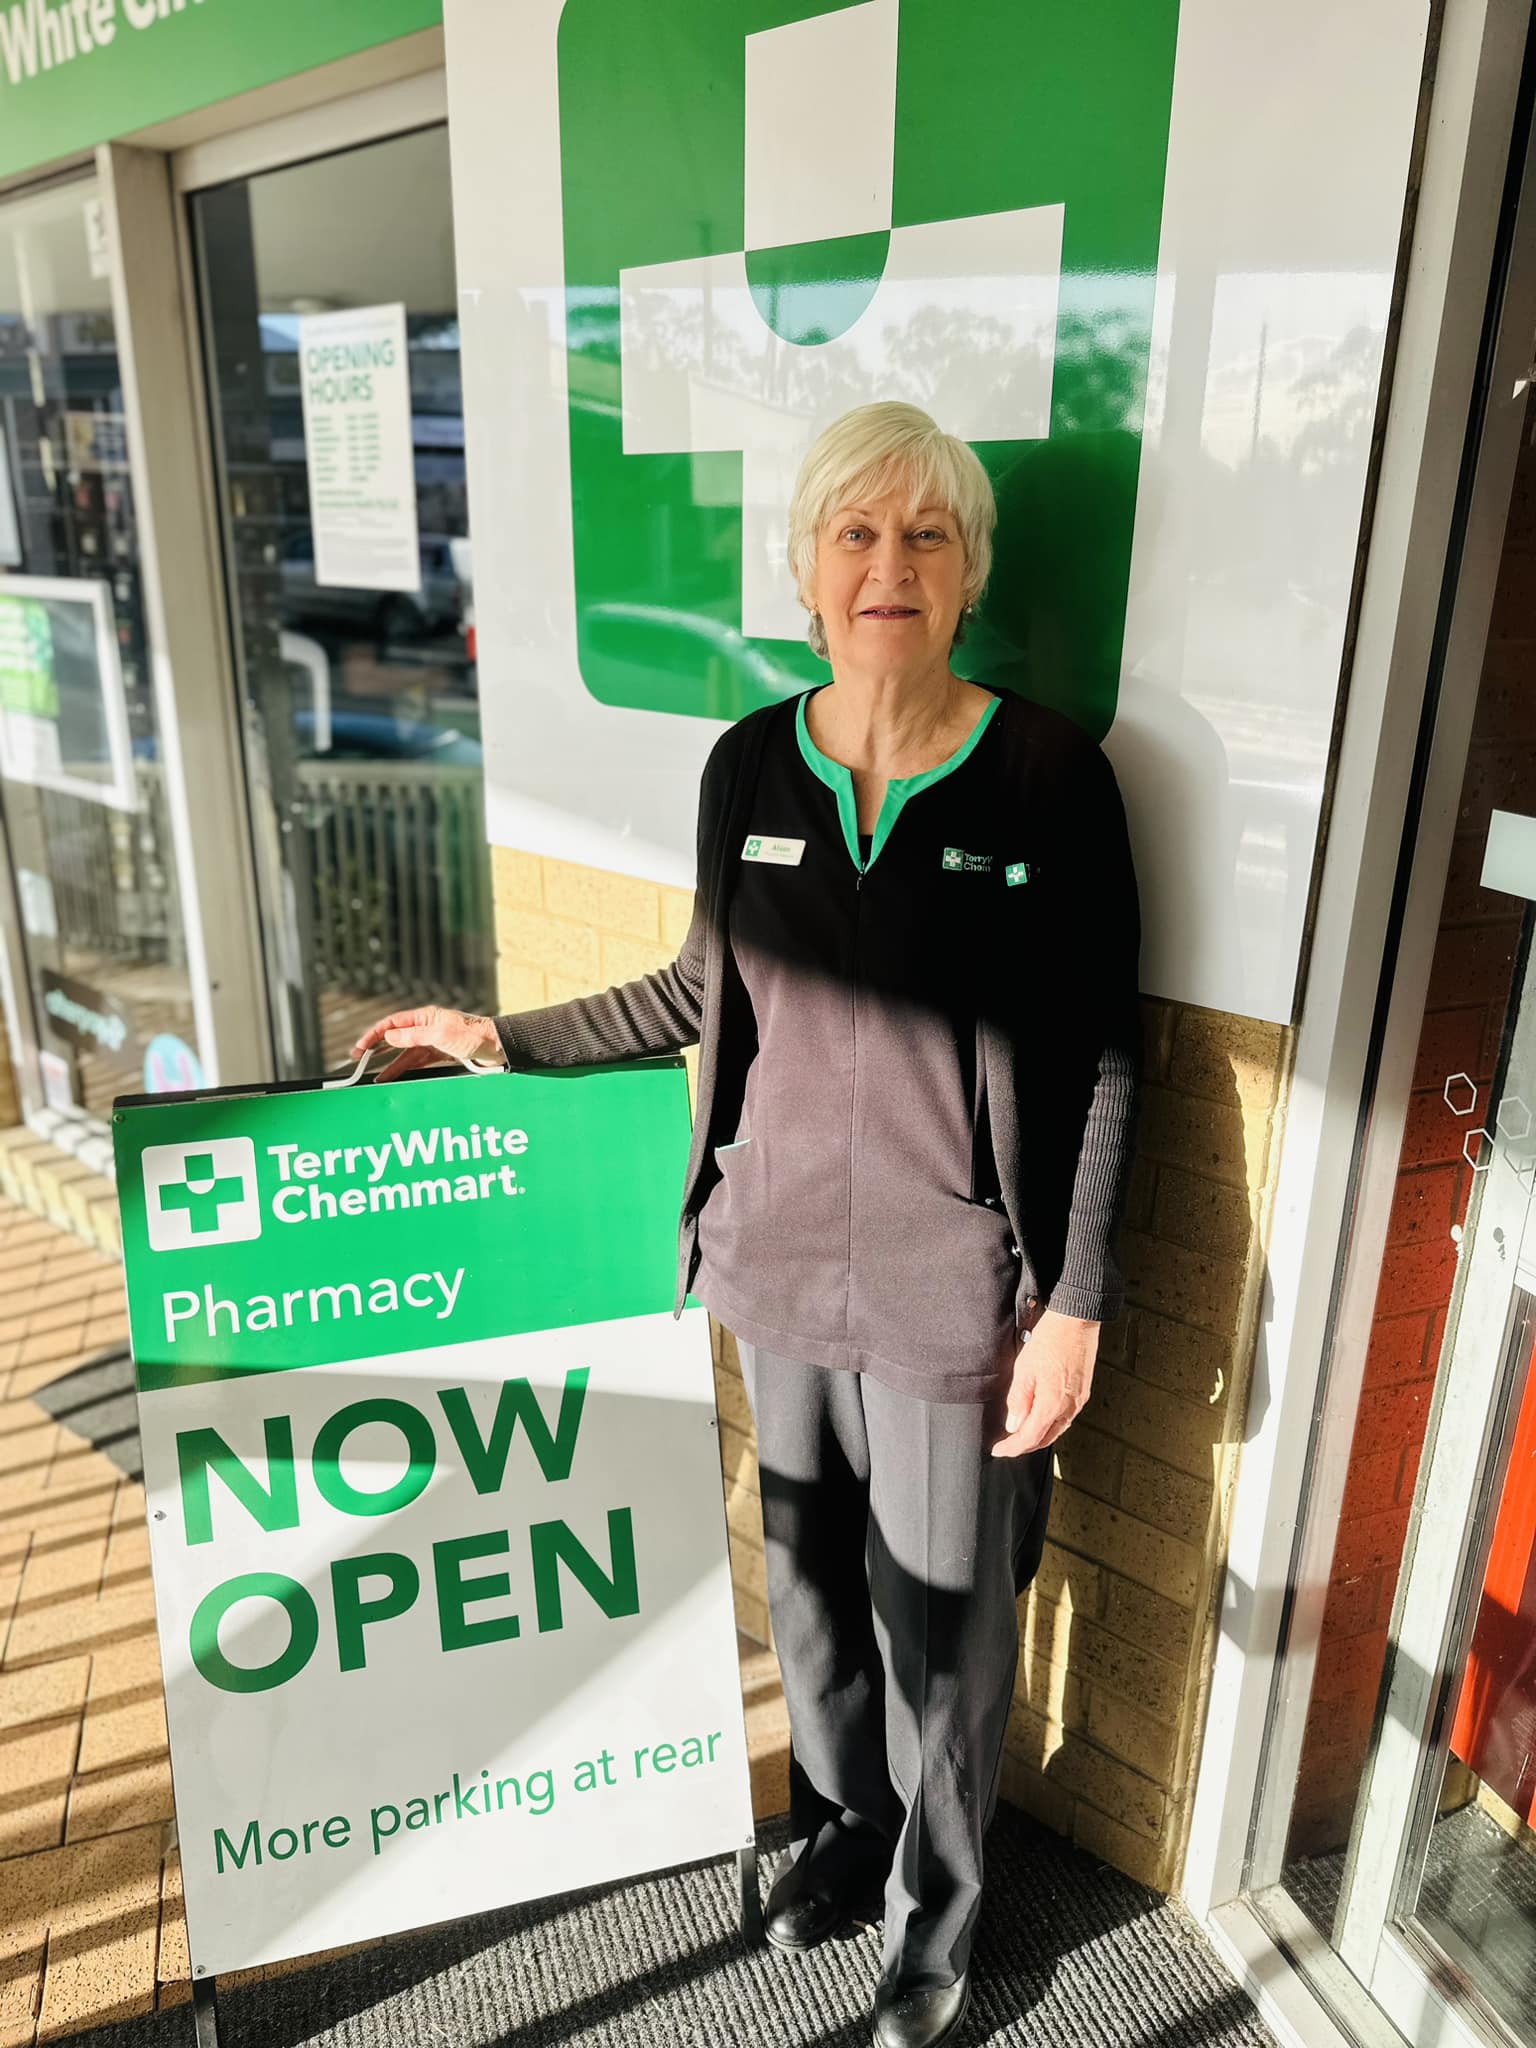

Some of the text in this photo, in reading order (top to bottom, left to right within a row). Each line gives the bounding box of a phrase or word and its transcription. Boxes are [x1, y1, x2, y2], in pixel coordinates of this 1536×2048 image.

[307, 338, 396, 373] OPENING
[309, 374, 373, 404] HOURS
[267, 1123, 529, 1182] TerryWhite
[162, 1267, 465, 1343] Pharmacy
[175, 1366, 591, 1546] NOW
[189, 1506, 640, 1694] OPEN
[213, 1731, 722, 1874] More parking at rear
